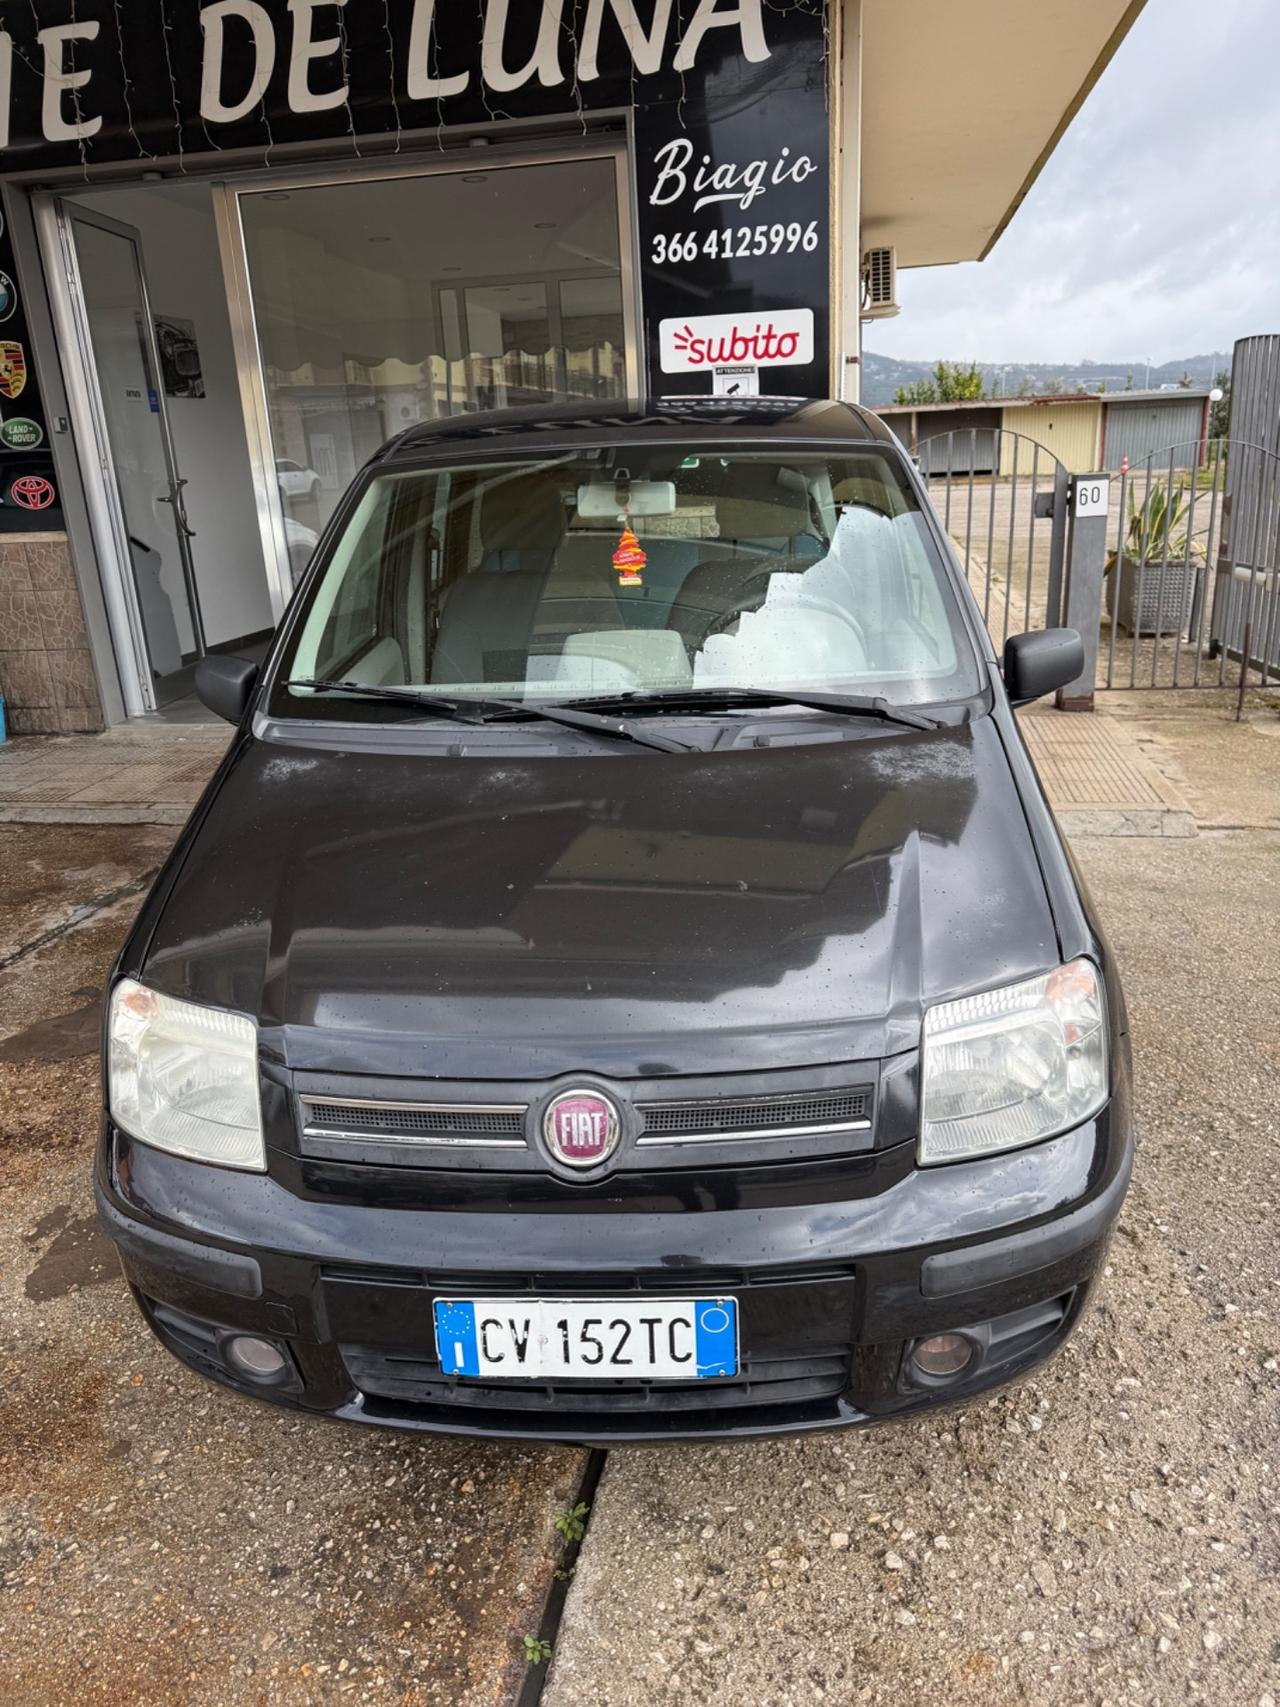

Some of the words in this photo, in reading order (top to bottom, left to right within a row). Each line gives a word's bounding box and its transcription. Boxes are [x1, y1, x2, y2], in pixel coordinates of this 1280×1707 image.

[200, 0, 350, 123] DE
[407, 0, 772, 100] LUNA
[649, 138, 818, 213] Biagio
[651, 231, 697, 264] 366
[702, 221, 819, 260] 4125996
[687, 323, 800, 364] subito
[1079, 486, 1101, 506] 60
[561, 1112, 603, 1147] FIAT
[479, 1318, 531, 1364] CV
[556, 1317, 693, 1365] 152TC
